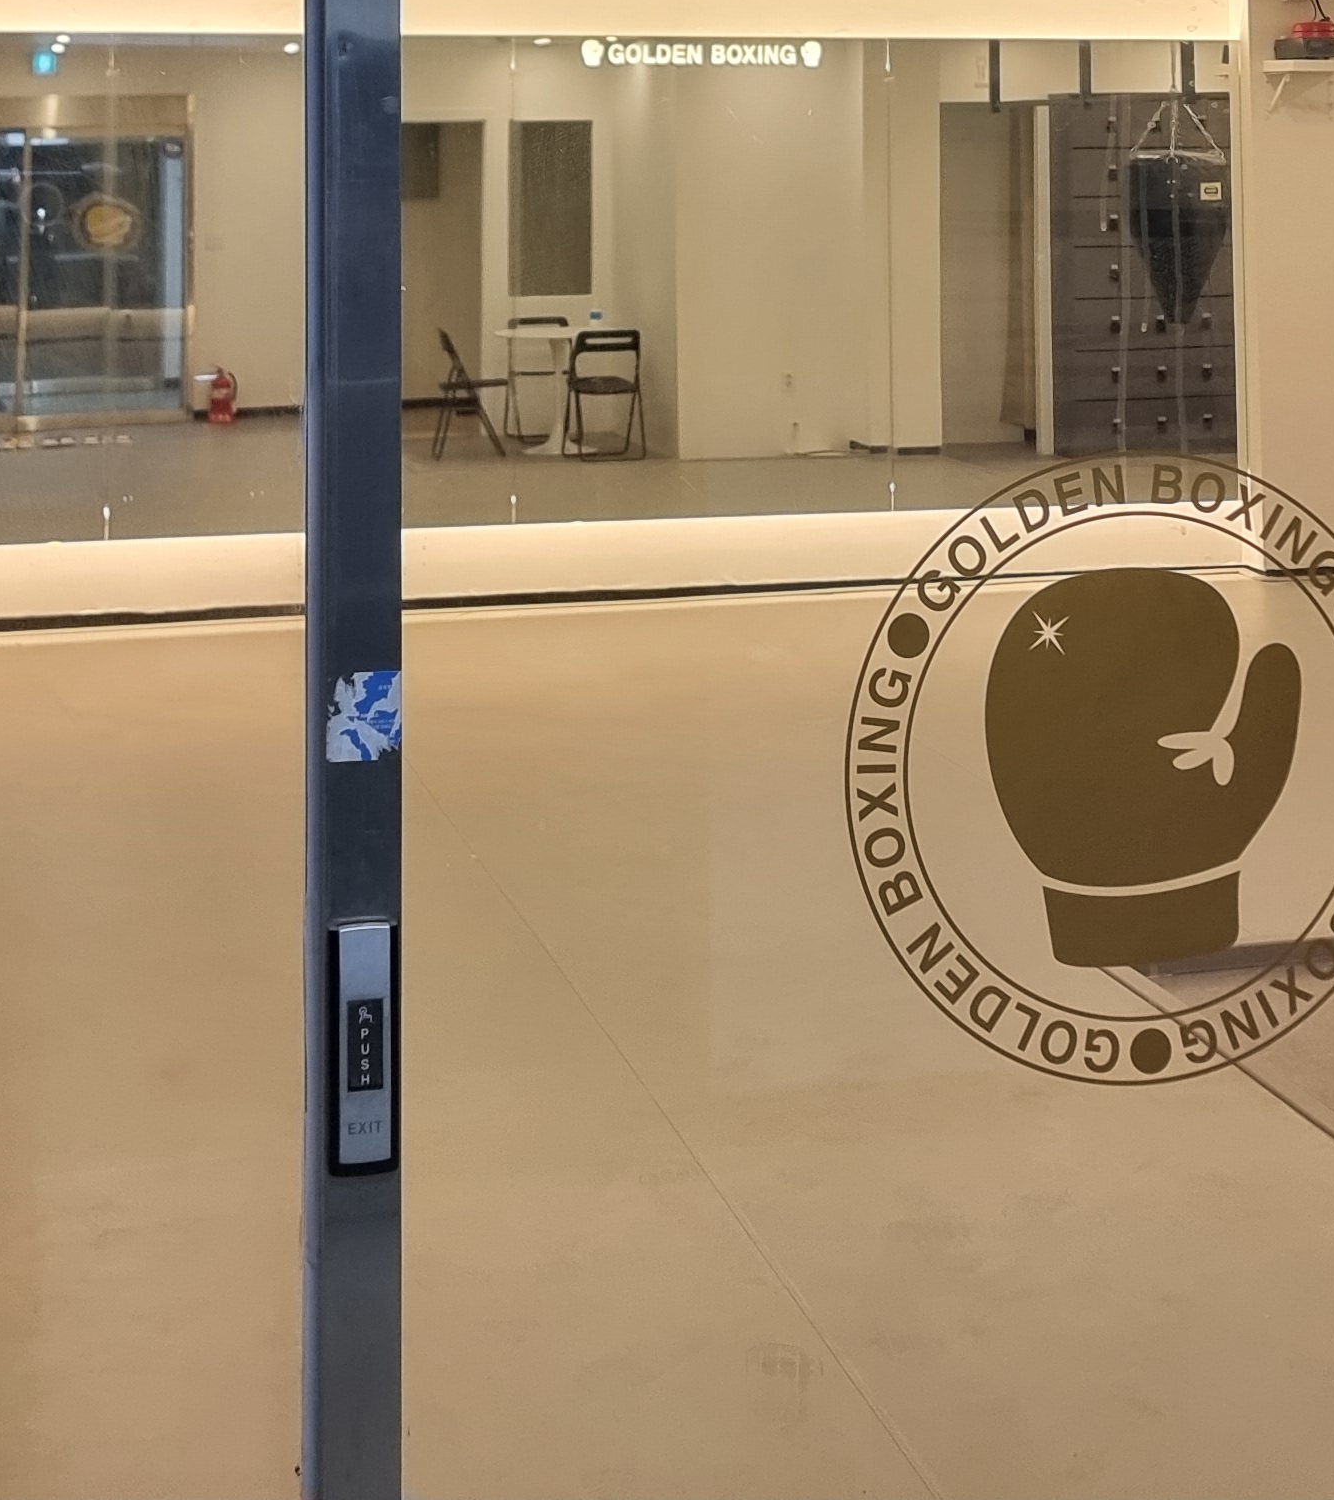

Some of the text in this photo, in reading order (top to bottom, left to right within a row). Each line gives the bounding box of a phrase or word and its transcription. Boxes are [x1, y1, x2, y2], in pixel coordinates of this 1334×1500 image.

[607, 43, 798, 66] GOLDEN BOXING
[917, 464, 1126, 613] GOLDEN
[856, 666, 1121, 1074] GOLDEN BOXING
[360, 1028, 370, 1086] PUSH
[347, 1120, 383, 1135] EXIT
